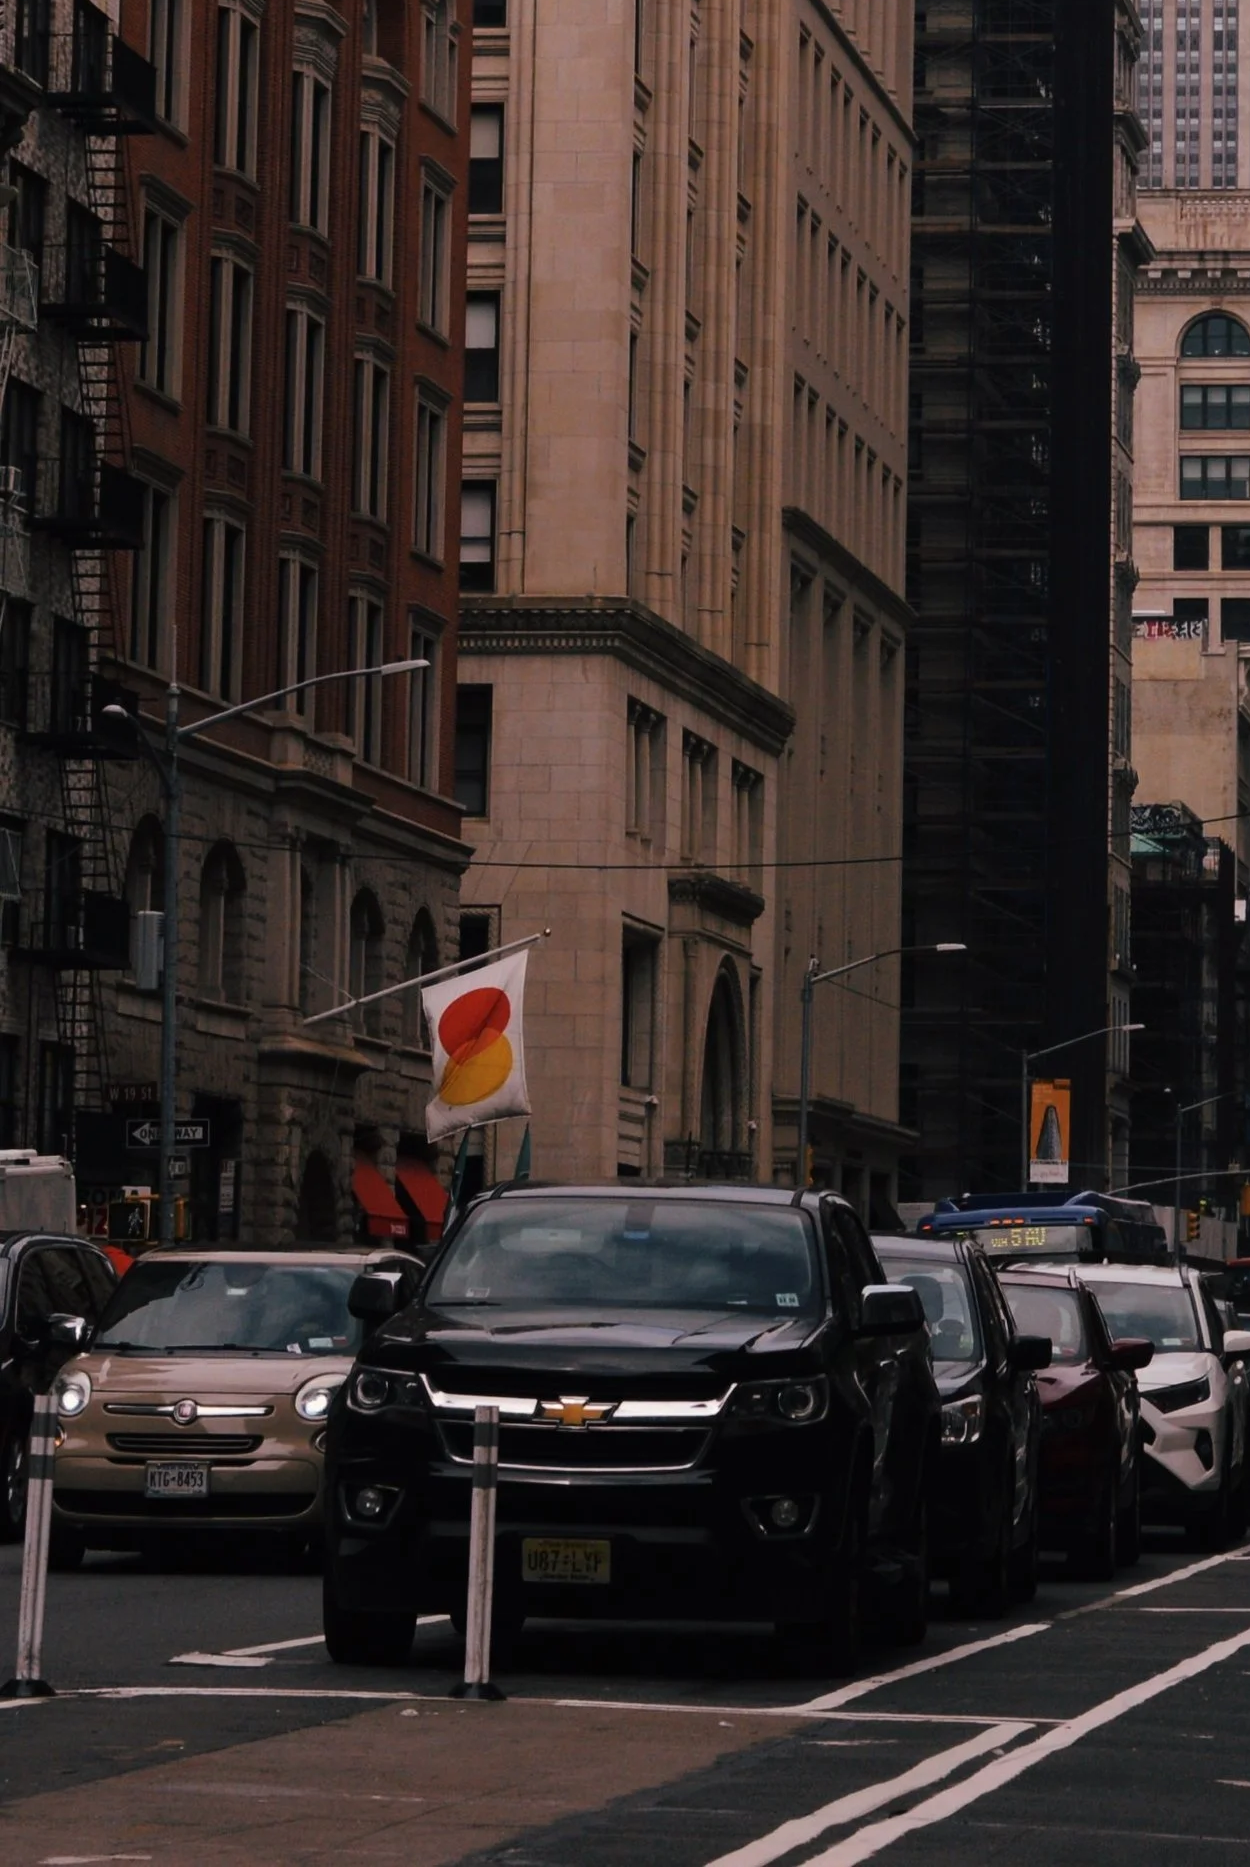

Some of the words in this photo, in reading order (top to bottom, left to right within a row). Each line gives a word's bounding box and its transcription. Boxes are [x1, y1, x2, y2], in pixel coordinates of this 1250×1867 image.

[109, 1087, 120, 1101] W
[124, 1086, 136, 1101] 19
[1011, 1228, 1022, 1247] 5
